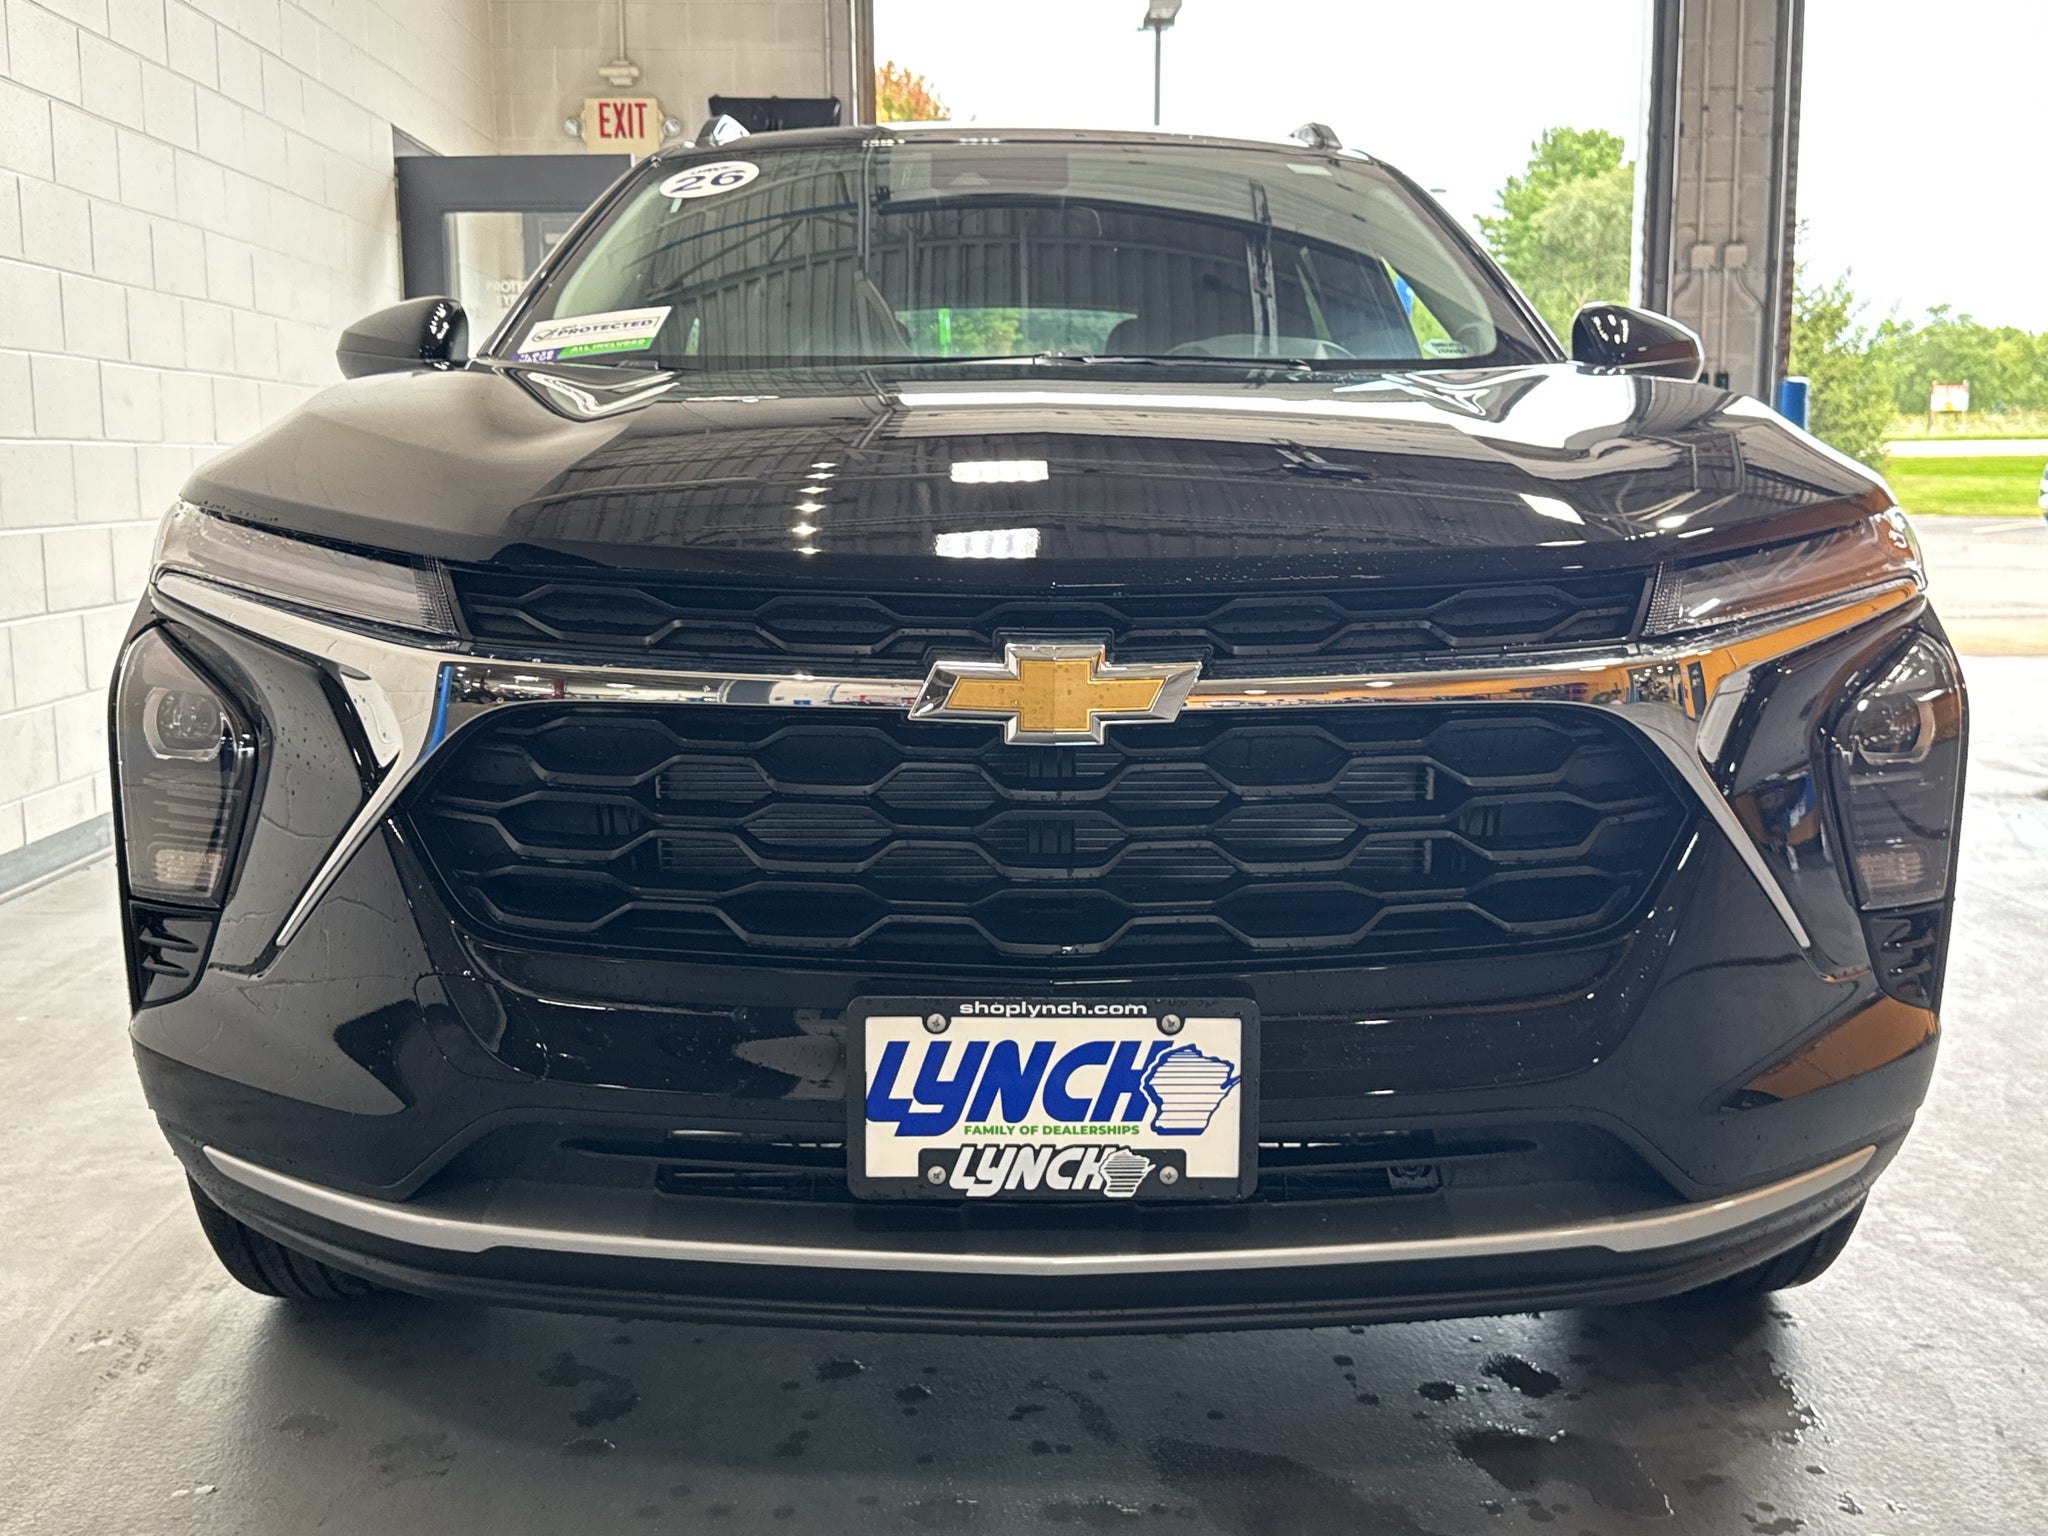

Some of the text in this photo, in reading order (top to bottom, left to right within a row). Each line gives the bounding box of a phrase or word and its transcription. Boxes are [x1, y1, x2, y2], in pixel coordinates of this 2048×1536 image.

[598, 102, 648, 138] EXIT
[669, 169, 746, 194] 26
[557, 319, 653, 337] PROTECTED
[959, 1001, 1148, 1017] shoplynch.com
[866, 1040, 1174, 1137] LYNCH
[964, 1124, 1140, 1136] FAMILY OF DEALERSHIPS
[948, 1145, 1120, 1197] LYNCH
